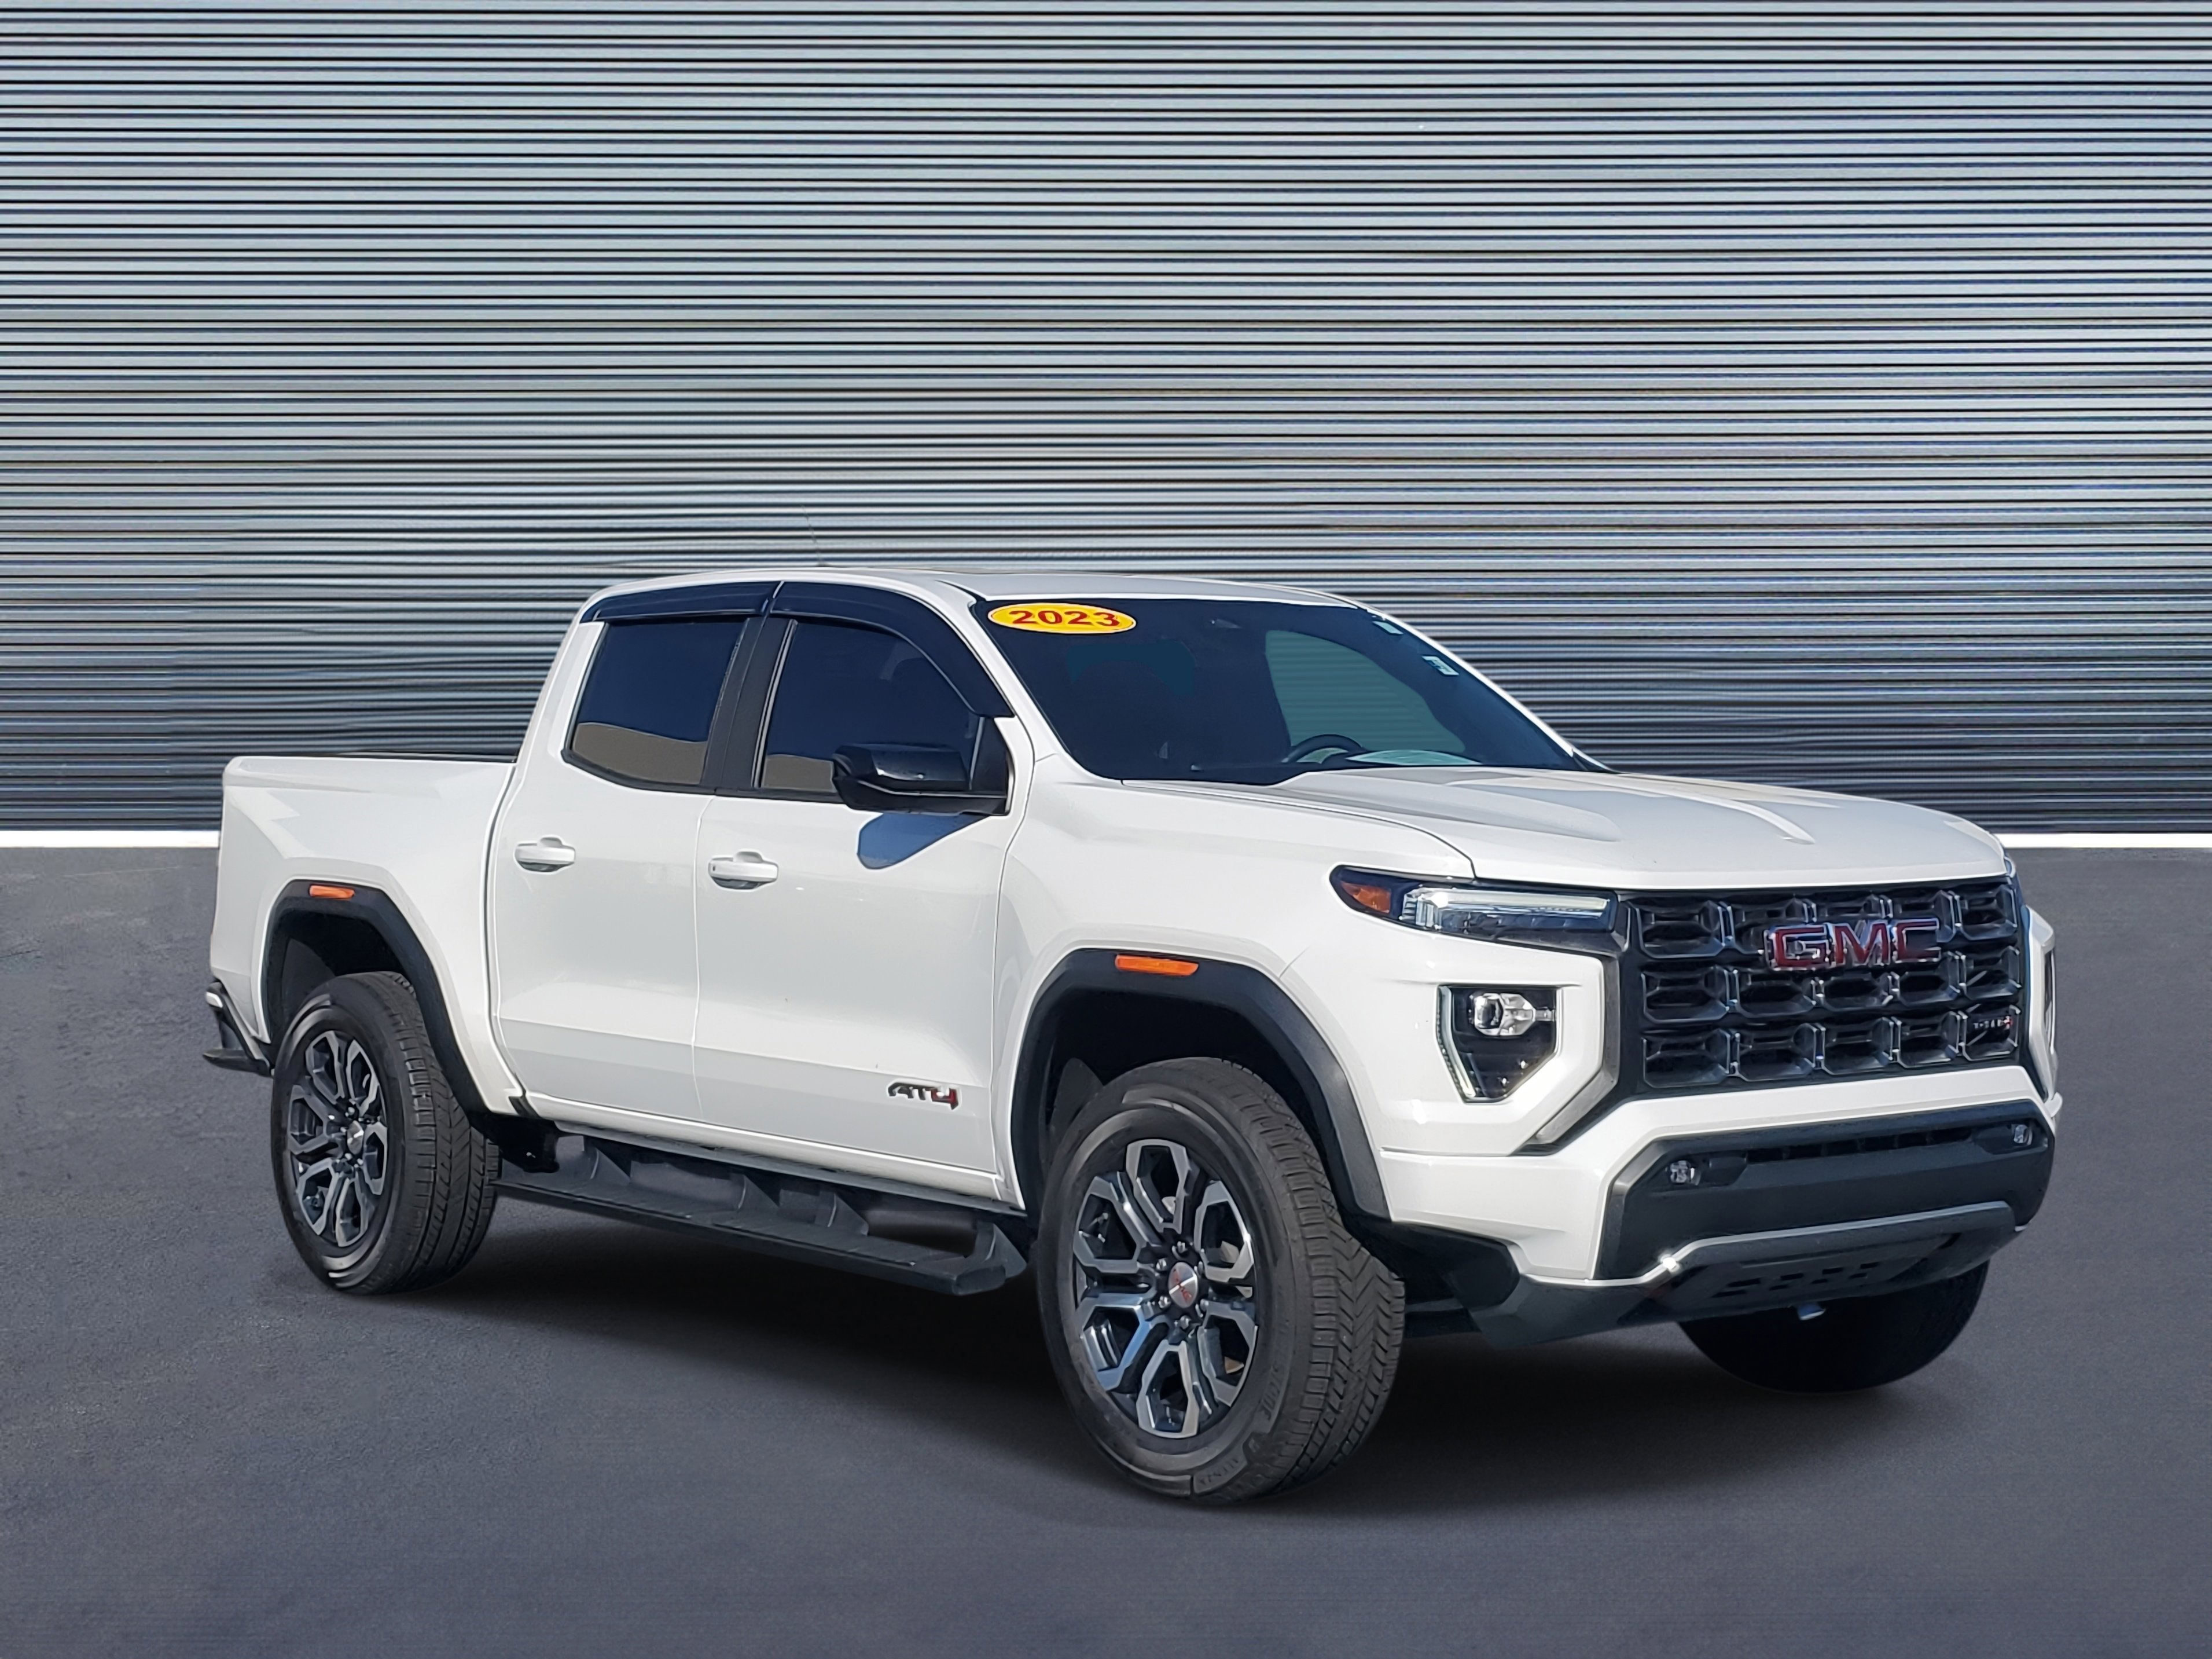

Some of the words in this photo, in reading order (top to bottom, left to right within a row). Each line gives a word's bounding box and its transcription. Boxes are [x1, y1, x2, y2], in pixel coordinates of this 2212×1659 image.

[1009, 610, 1120, 627] 2023
[1765, 919, 1941, 971] GMC
[888, 1082, 959, 1110] AT4
